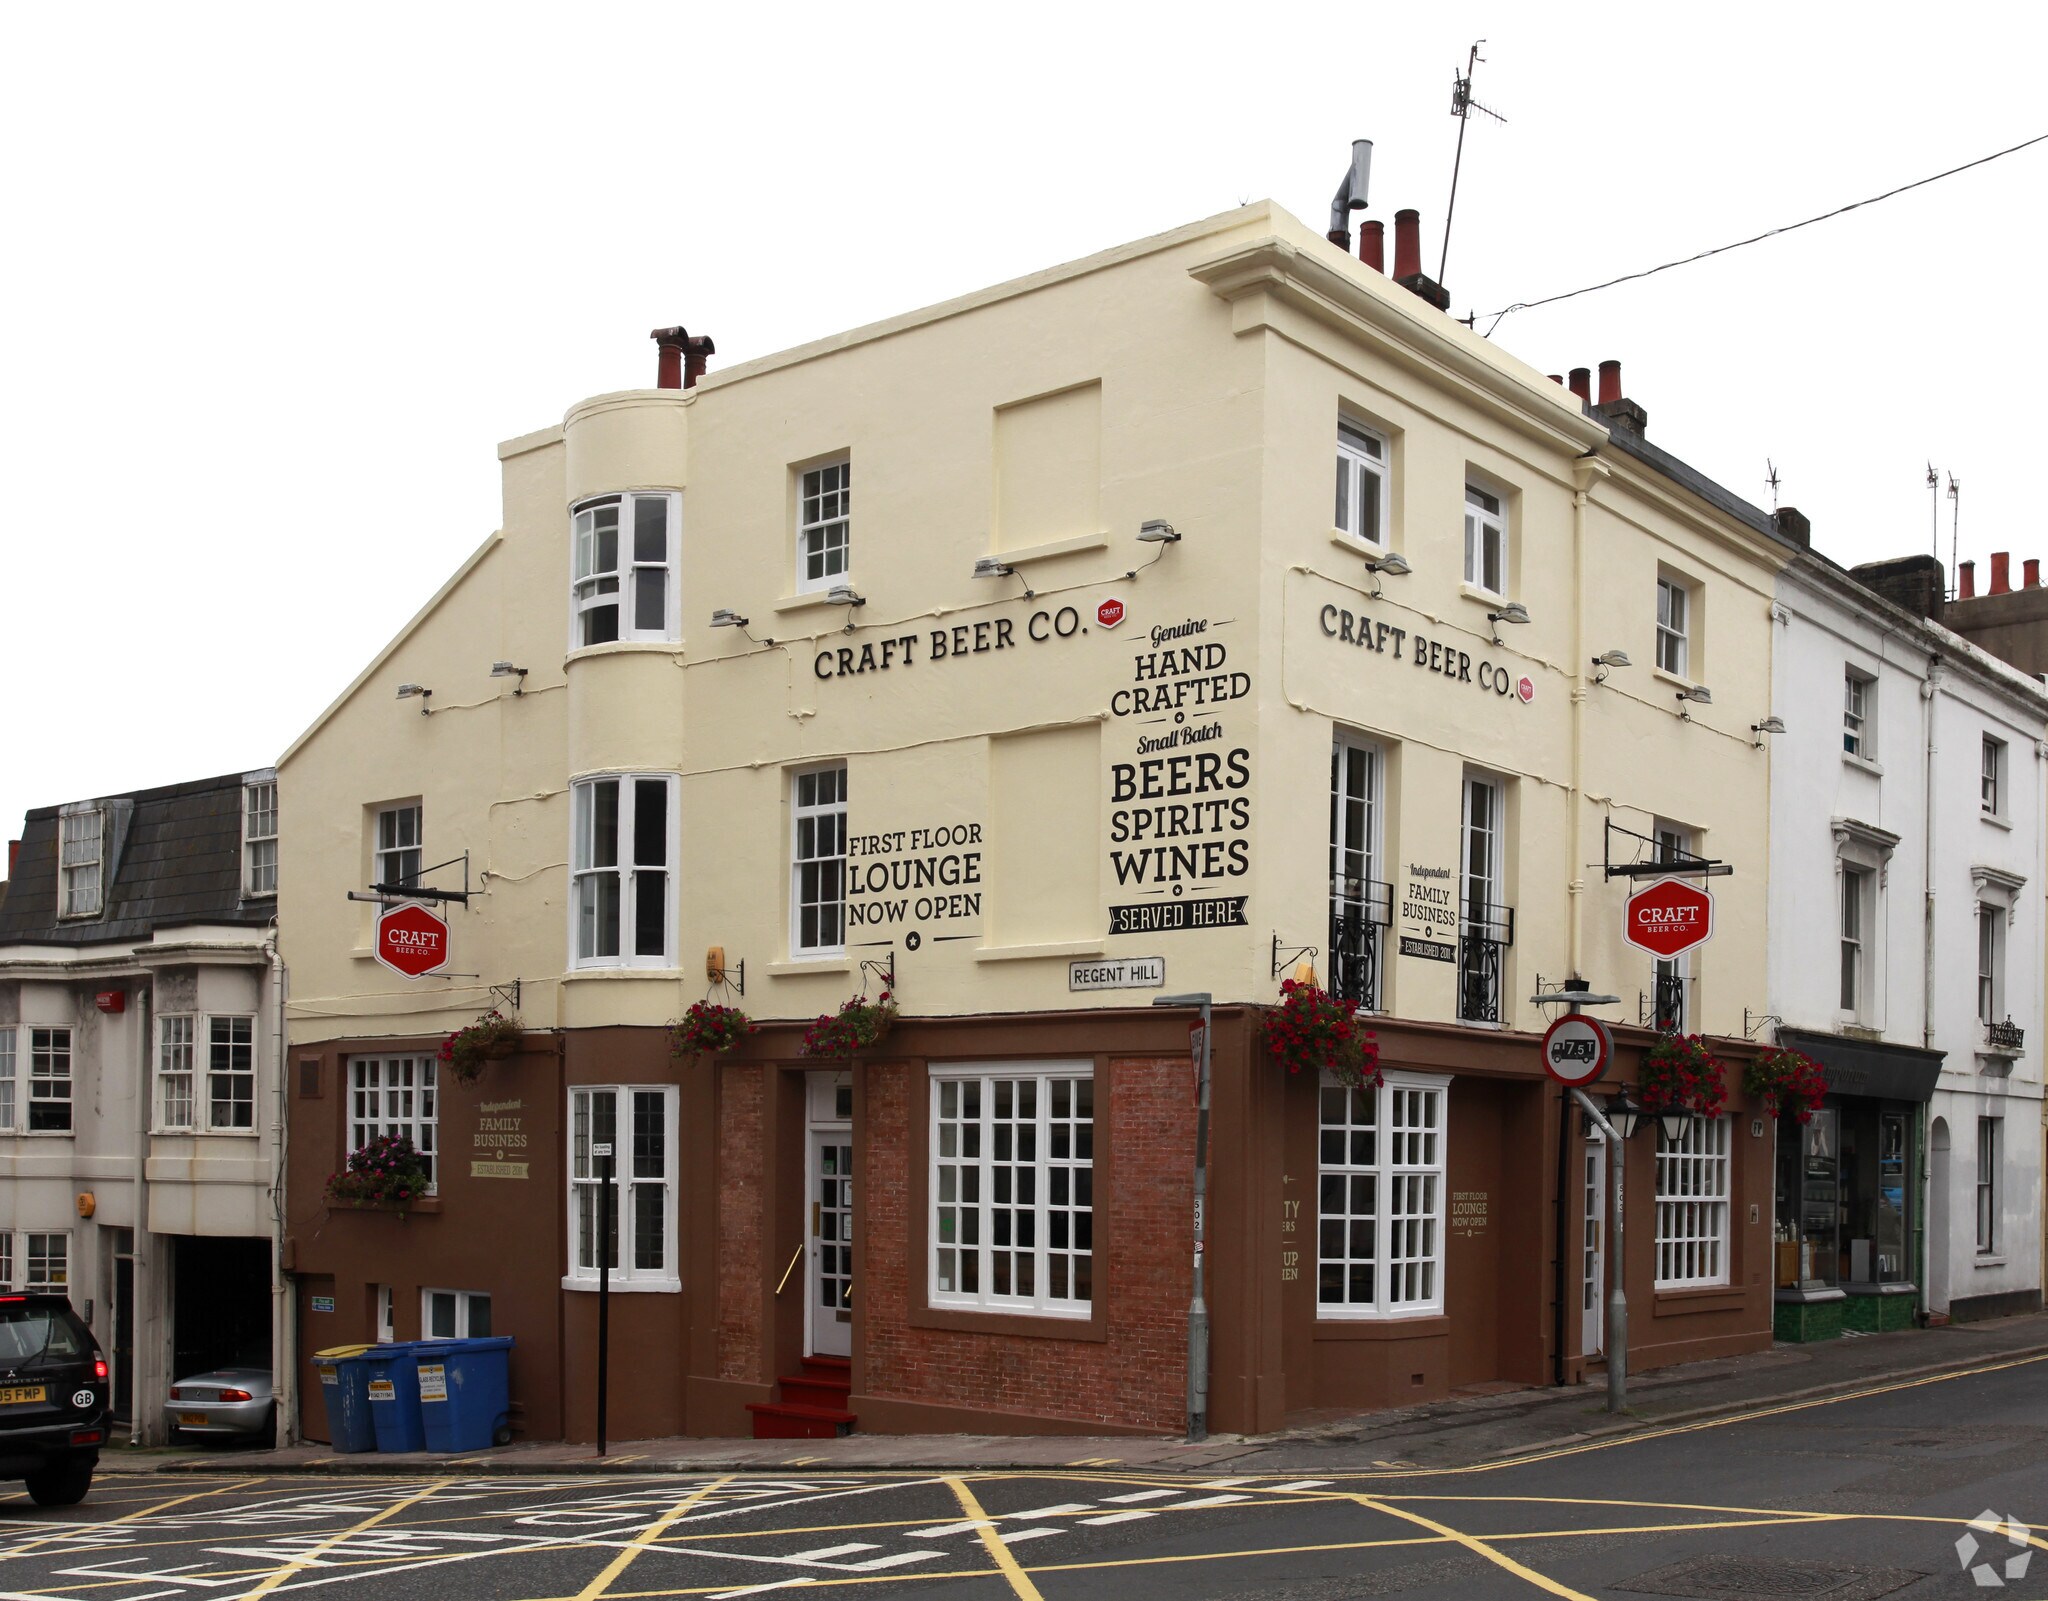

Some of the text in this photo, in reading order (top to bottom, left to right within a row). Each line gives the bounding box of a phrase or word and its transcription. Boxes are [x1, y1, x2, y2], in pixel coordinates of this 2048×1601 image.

[1100, 606, 1121, 616] CRAFT
[1151, 618, 1208, 648] Genuine
[814, 606, 1088, 679] CRAFT BEER CO.
[1320, 604, 1514, 698] CRAFT BEER CO.
[1135, 643, 1226, 681] HAND
[1111, 672, 1251, 716] CRAFTED
[1137, 721, 1222, 754] Small Batch
[1112, 748, 1250, 803] BEERS
[1111, 797, 1250, 842] SPIRITS
[849, 823, 982, 856] FIRST FLOOR
[1110, 839, 1249, 885] WINES
[849, 853, 981, 894] LOUNGE
[1410, 863, 1450, 880] Independent
[1409, 883, 1450, 905] FAMILY
[849, 893, 982, 926] NOW OPEN
[1120, 900, 1238, 930] SERVED HERE
[1402, 902, 1455, 926] BUSINESS
[1638, 906, 1699, 922] CRAFT
[388, 929, 439, 946] CRAFT
[1647, 925, 1669, 933] BEER
[1405, 941, 1451, 959] ESTABLISHED 2011
[1074, 965, 1158, 983] REGENT HILL
[1823, 1066, 1871, 1086] mporium
[480, 1118, 522, 1131] FAMILY
[1753, 1122, 1762, 1134] FP
[473, 1134, 528, 1147] BUSINESS
[1452, 1192, 1488, 1200] FIRST FLOOR
[1283, 1200, 1300, 1218] TY
[1452, 1202, 1488, 1215] LOUNGE
[1282, 1221, 1295, 1231] ERS
[1452, 1217, 1487, 1227] NOW OPEN
[1283, 1252, 1299, 1266] UP
[16, 1388, 41, 1400] FMP
[75, 1393, 94, 1405] GB
